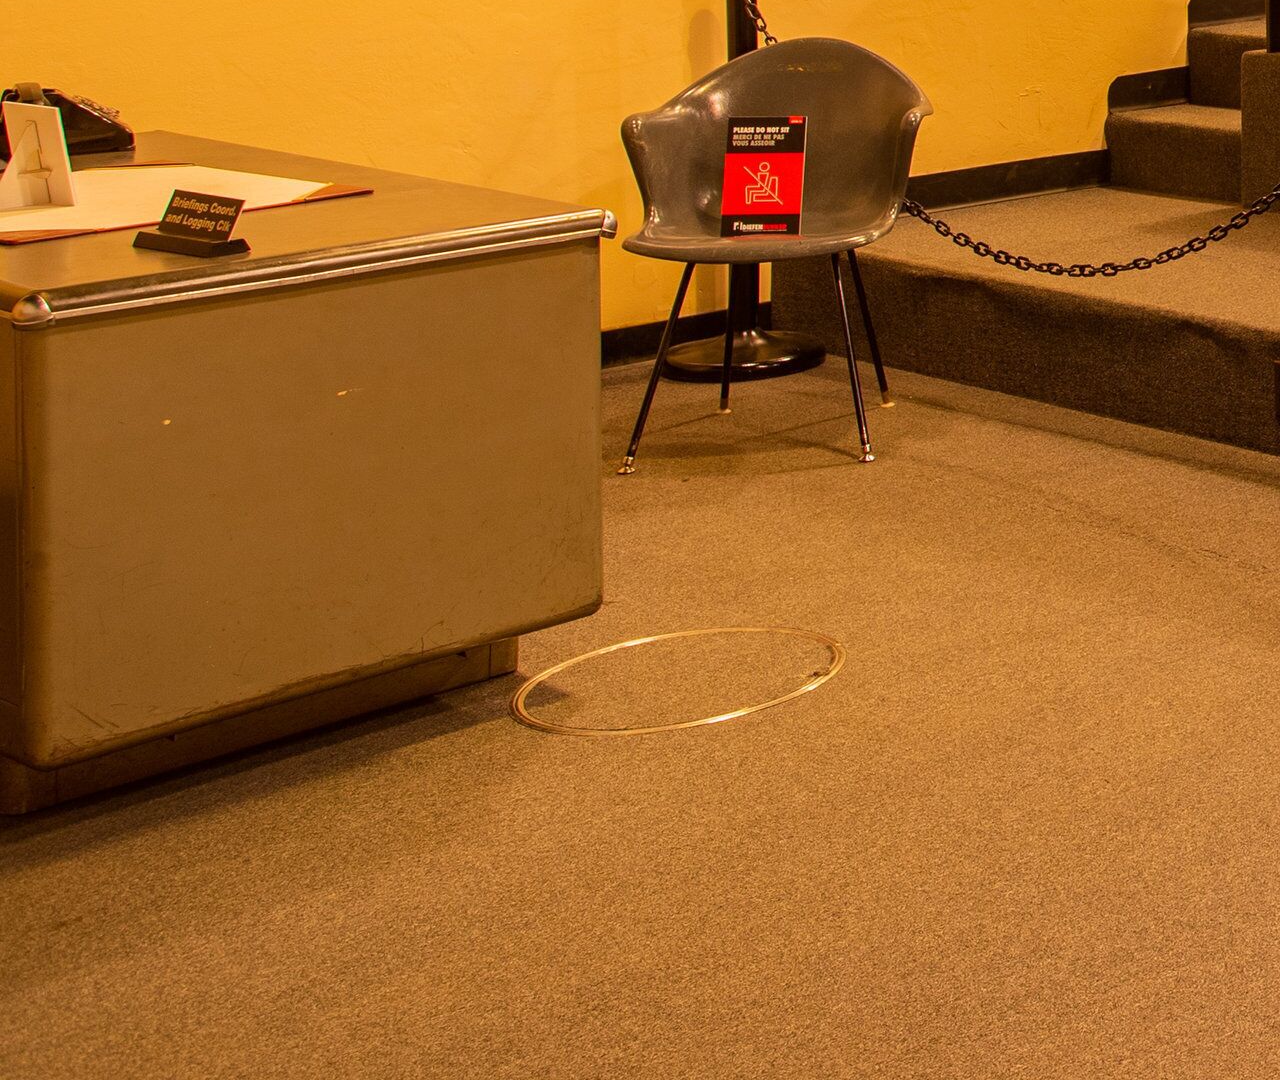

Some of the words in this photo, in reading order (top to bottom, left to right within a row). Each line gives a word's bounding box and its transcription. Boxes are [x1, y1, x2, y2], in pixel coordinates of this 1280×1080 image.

[172, 197, 209, 213] Briefings
[210, 202, 237, 216] Coord.
[165, 213, 181, 224] and
[182, 214, 216, 232] Logging
[217, 220, 231, 232] Clk
